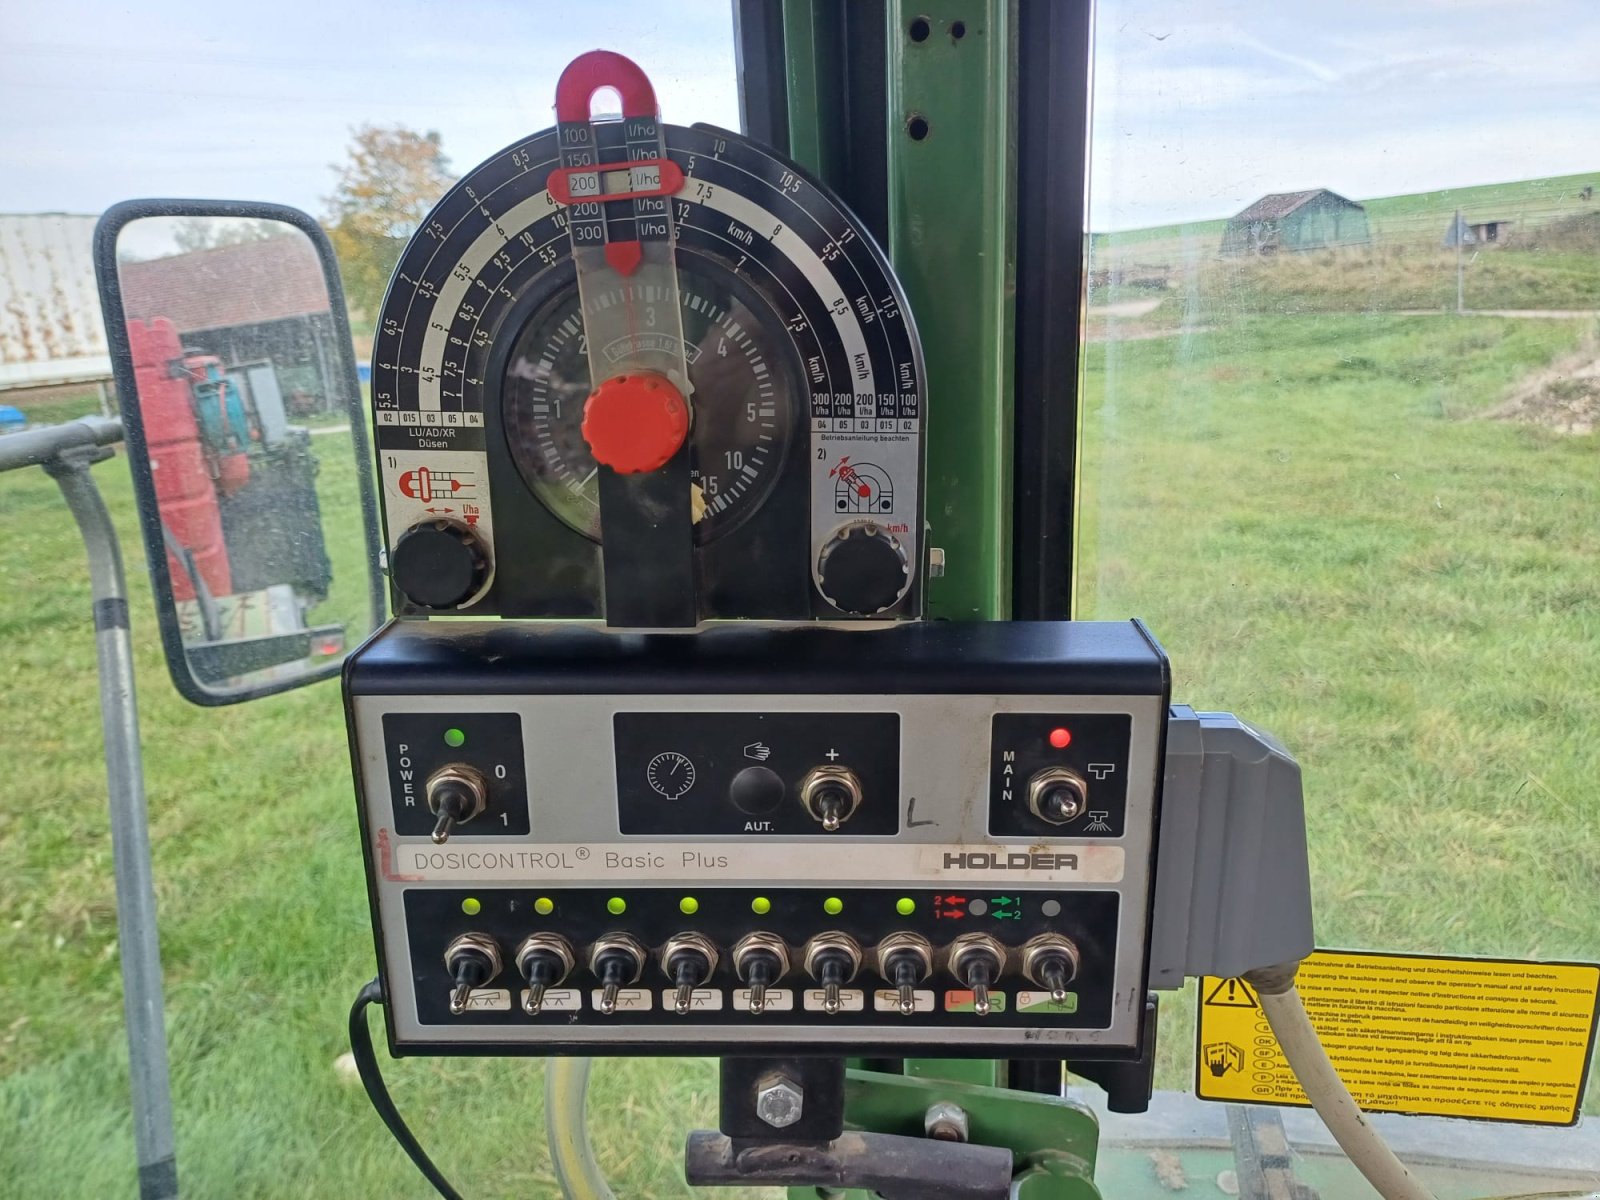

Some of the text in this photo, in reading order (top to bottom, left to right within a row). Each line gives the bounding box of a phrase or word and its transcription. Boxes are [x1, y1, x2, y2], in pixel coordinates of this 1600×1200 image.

[565, 124, 655, 142] 100 l/ha
[713, 140, 726, 153] 10
[512, 149, 530, 166] 8.5
[567, 149, 657, 167] 150 l/ha
[688, 157, 695, 169] 5
[571, 177, 596, 191] 200
[779, 172, 802, 193] 10.5
[466, 187, 475, 198] 8
[696, 183, 713, 198] 7.5
[480, 206, 490, 216] 4
[574, 199, 664, 216] 200 l/ha
[678, 203, 690, 218] 12
[426, 220, 443, 239] 7.5
[496, 224, 504, 236] 6
[576, 226, 602, 240] 300
[641, 224, 666, 236] l/ha
[727, 222, 754, 246] km/h
[773, 225, 782, 236] 8
[841, 228, 855, 244] 11
[519, 232, 534, 248] 10
[539, 246, 556, 263] 5.5
[822, 242, 840, 261] 5.5
[494, 251, 510, 269] 9.5
[737, 256, 747, 267] 7
[400, 273, 412, 283] 7
[454, 263, 471, 282] 5.5
[419, 280, 434, 298] 3.5
[477, 279, 487, 290] 9
[500, 286, 511, 297] 5
[459, 303, 475, 321] 8.5
[832, 298, 849, 315] 8.5
[855, 295, 876, 324] km/h
[880, 295, 899, 319] 11.5
[646, 307, 656, 326] 3
[790, 314, 807, 332] 7.5
[384, 319, 398, 336] 6.5
[432, 322, 444, 331] 5
[450, 337, 462, 345] 8
[474, 329, 489, 347] 4.5
[578, 336, 587, 354] 2
[718, 338, 728, 357] 4
[401, 366, 413, 374] 3
[444, 361, 457, 377] 7.5
[808, 356, 825, 383] km/h
[854, 352, 870, 380] km/h
[422, 367, 435, 383] 4.5
[900, 362, 914, 389] km/h
[378, 393, 391, 408] 5.5
[812, 393, 916, 406] 300 200 200 150 100
[554, 400, 561, 418] 1
[747, 403, 756, 422] 5
[384, 413, 478, 423] 02 015 03 05 04
[839, 421, 847, 429] 05
[860, 421, 869, 429] 03
[880, 421, 892, 429] 015
[903, 422, 912, 430] 02
[409, 428, 456, 438] LU/AD/XR
[821, 434, 878, 442] Betriebsanleitung
[418, 439, 448, 448] Düsen
[725, 451, 742, 469] 10
[817, 448, 826, 460] 2)
[388, 457, 397, 469] 1)
[701, 476, 718, 494] 15
[462, 504, 479, 514] l/ha
[887, 524, 908, 533] km/h
[399, 744, 416, 807] POWER
[495, 765, 506, 779] 0
[1003, 751, 1015, 800] MAIN
[500, 813, 508, 826] 1
[744, 821, 774, 832] AUT.
[606, 852, 665, 869] Basic
[682, 852, 728, 868] Plus
[943, 852, 1078, 871] HOLDER
[934, 896, 942, 904] 2
[1014, 911, 1021, 919] 2
[1356, 963, 1412, 972] Betriebsanleitung
[1427, 968, 1491, 976] Sicherheitshinweise
[1432, 992, 1476, 1000] d'instructions
[1444, 1004, 1479, 1012] particolare
[1479, 1022, 1555, 1031] veiligheidsvoorschriften
[1440, 1033, 1497, 1041] instruktionsboken
[1470, 1053, 1536, 1062] sikkerhedsforskrifter
